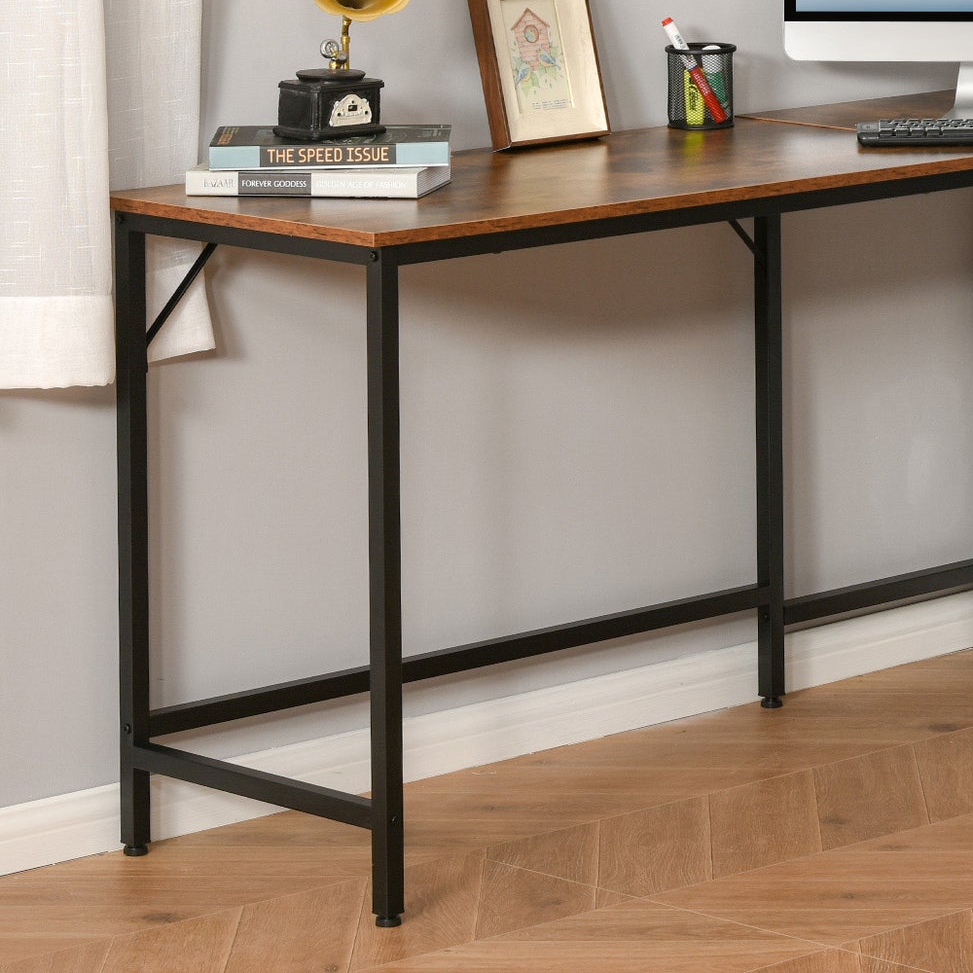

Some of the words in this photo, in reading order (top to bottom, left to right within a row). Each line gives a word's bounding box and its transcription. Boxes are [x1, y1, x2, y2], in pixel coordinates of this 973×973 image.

[267, 148, 295, 164] THE
[298, 147, 343, 163] SPEED
[346, 146, 390, 162] ISSUE
[241, 179, 272, 188] FOREVER
[273, 179, 307, 188] GODDESS
